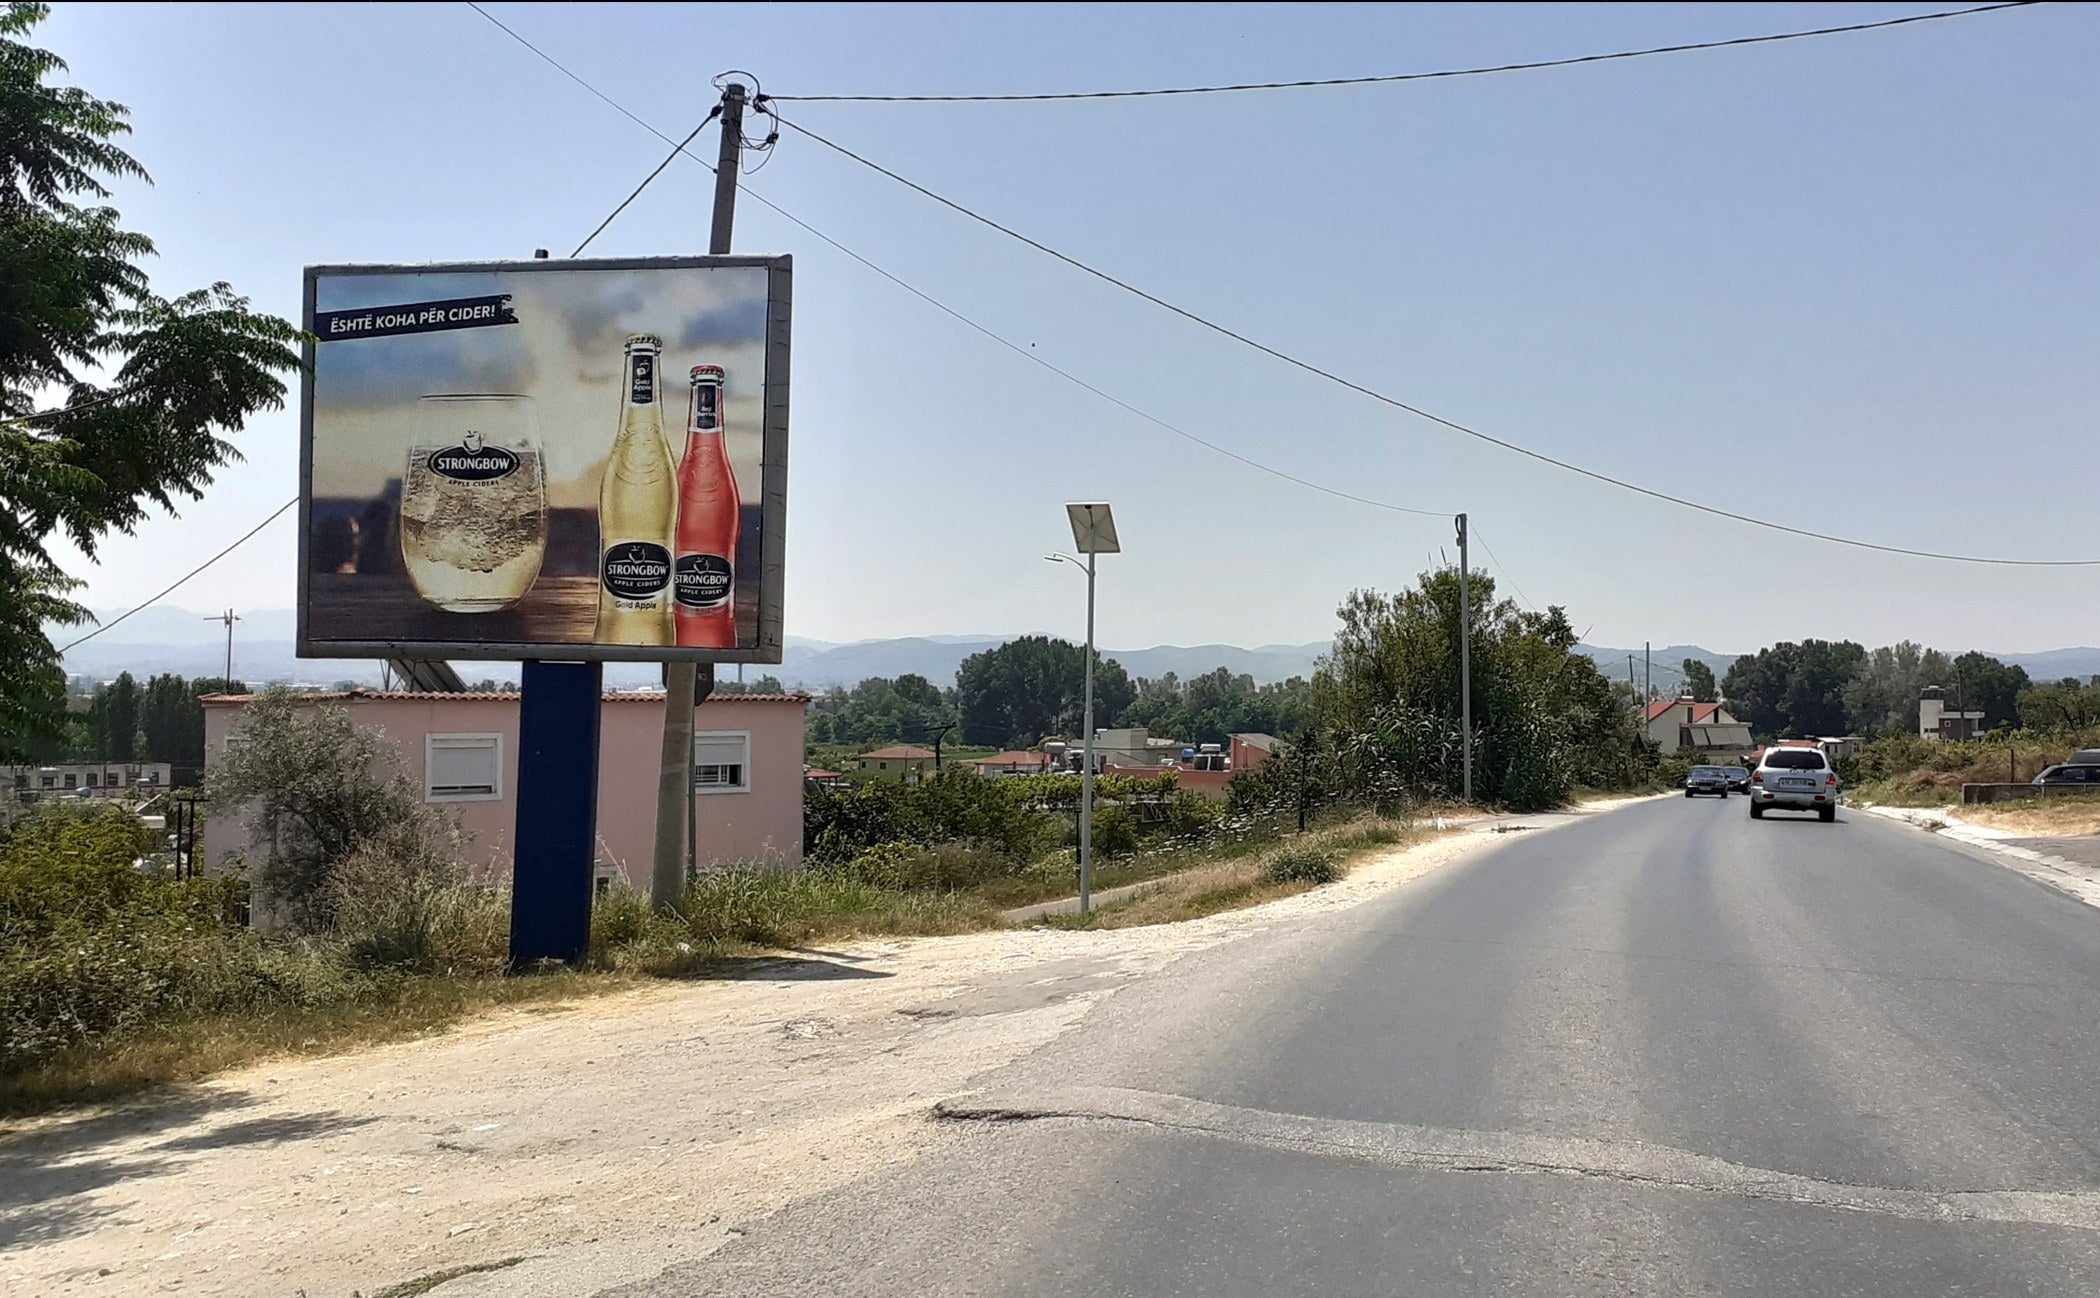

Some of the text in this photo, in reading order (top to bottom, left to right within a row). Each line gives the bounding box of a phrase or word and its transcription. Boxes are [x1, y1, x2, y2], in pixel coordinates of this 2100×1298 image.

[330, 305, 496, 333] ËSHTË KOHA PËR CIDER!
[437, 457, 510, 470] STRONGBOW
[448, 479, 470, 487] APPLE
[607, 564, 669, 576] STRONGBOW
[675, 574, 728, 585] STRONGBOW
[615, 601, 657, 610] Gold Apple
